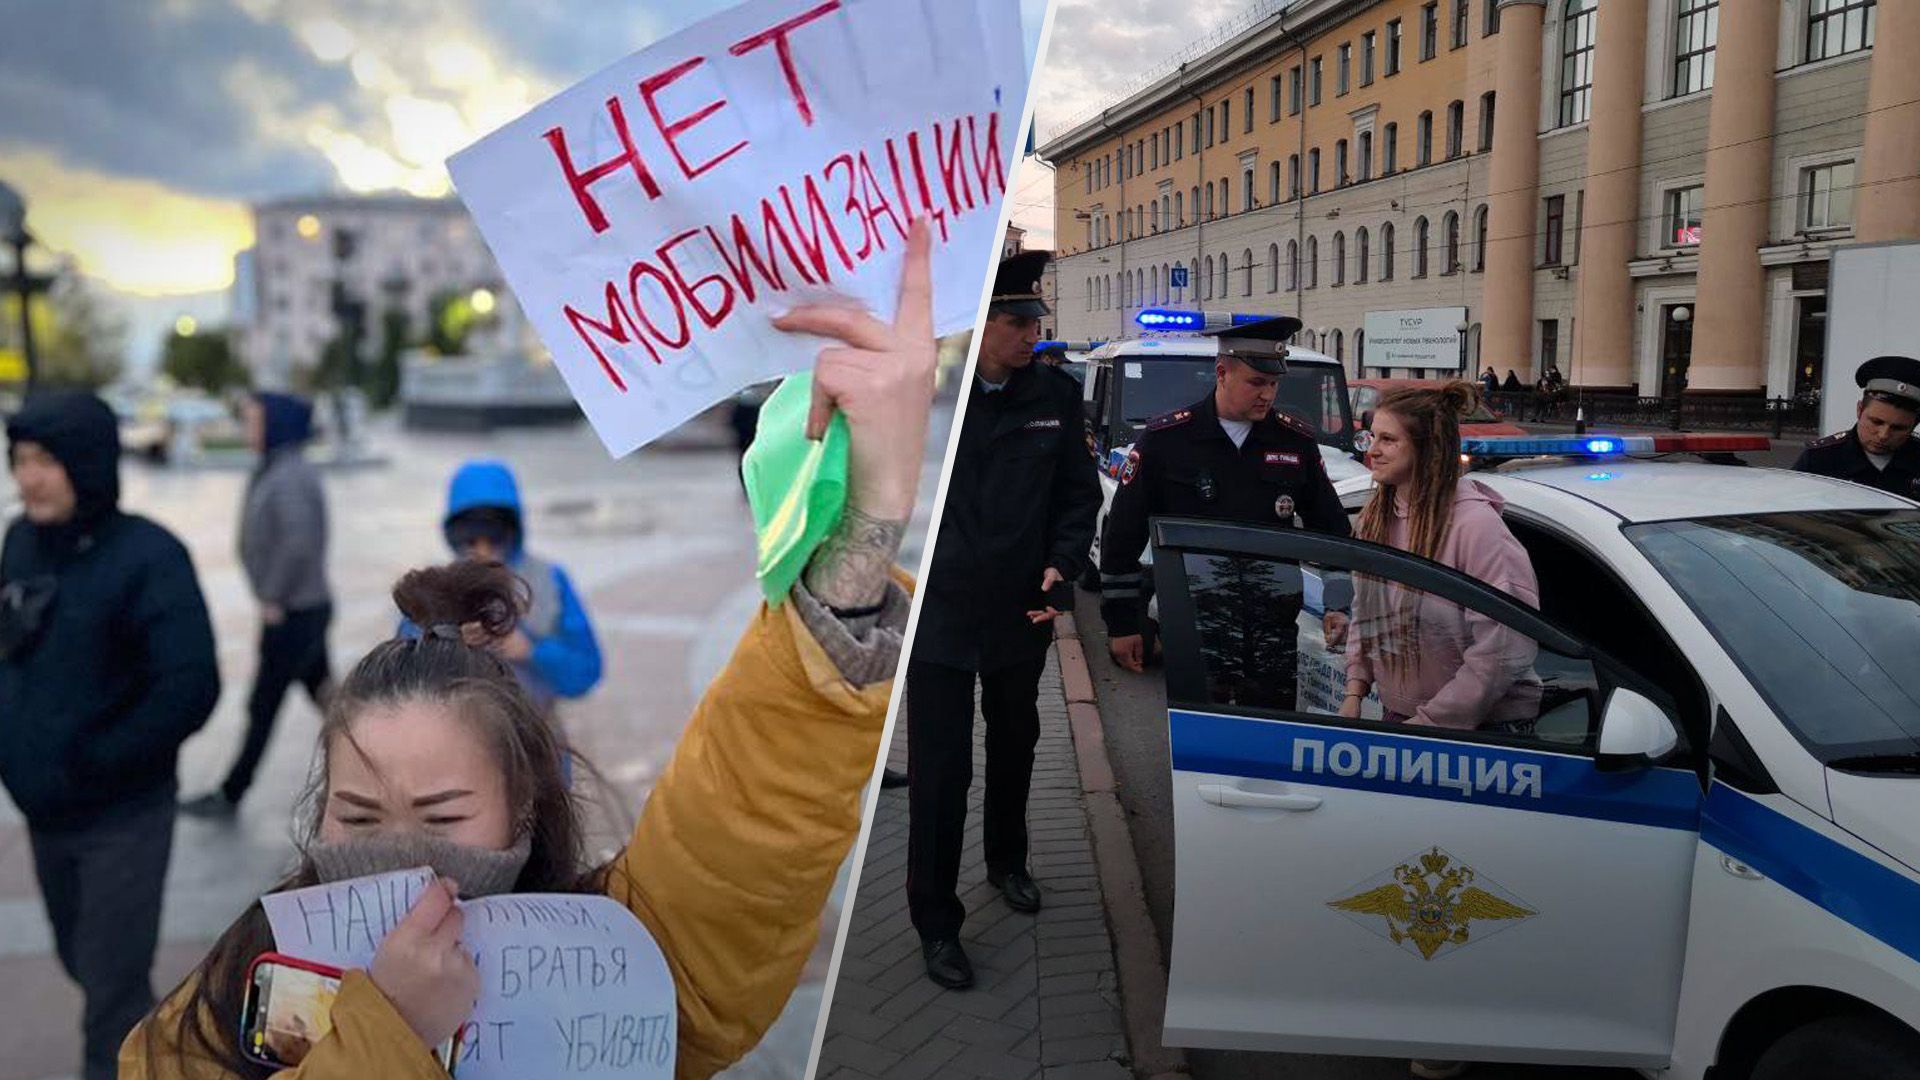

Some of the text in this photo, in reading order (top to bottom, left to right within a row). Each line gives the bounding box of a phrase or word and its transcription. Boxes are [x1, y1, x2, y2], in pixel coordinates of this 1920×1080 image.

[543, 0, 840, 233] НЕТ
[563, 112, 1006, 393] МОБИЛИЗАЦИИ
[1291, 737, 1543, 799] ПОЛИЦИЯ
[500, 945, 626, 998] БРАТЬЯ
[556, 1011, 670, 1072] УБИВАТЬ
